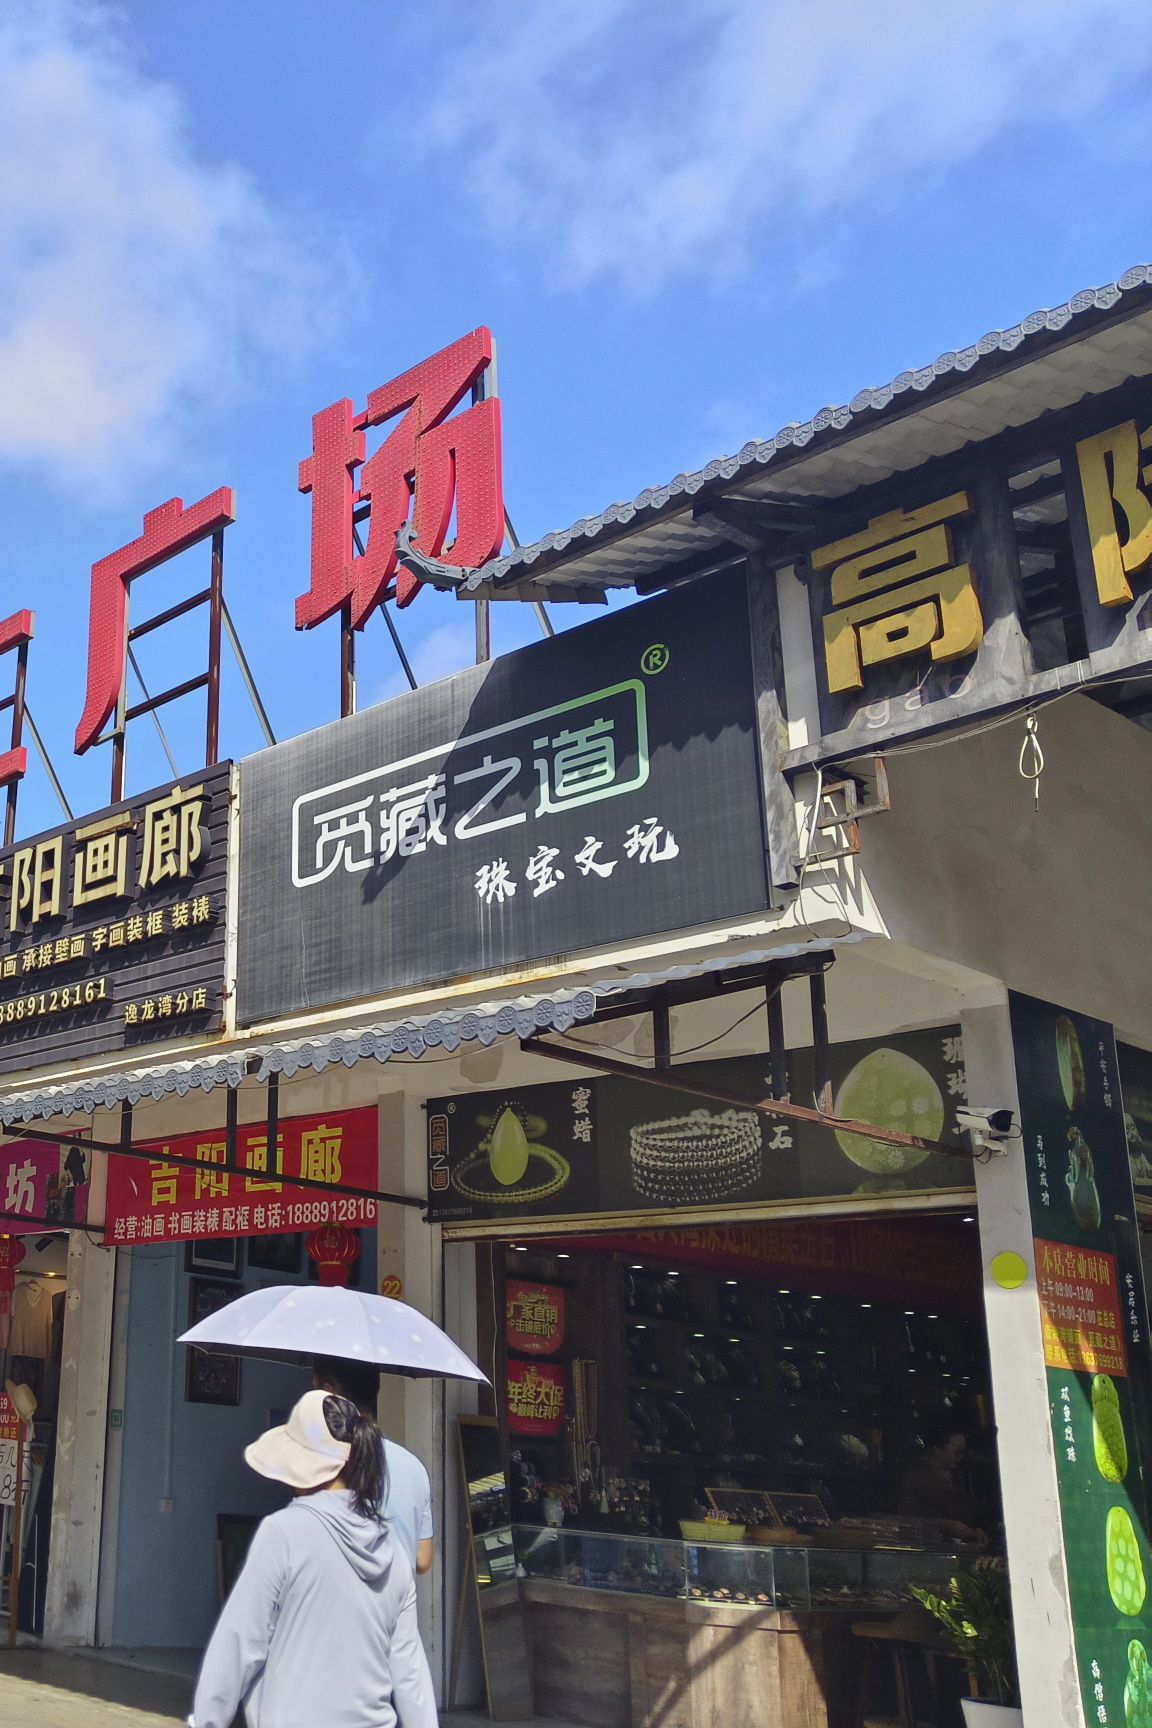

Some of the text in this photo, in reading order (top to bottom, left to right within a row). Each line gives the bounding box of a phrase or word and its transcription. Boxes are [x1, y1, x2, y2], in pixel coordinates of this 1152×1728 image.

[313, 717, 617, 875] 觅藏之道
[474, 817, 679, 905] 珠宝文玩
[22, 934, 86, 972] 承接壁画
[92, 913, 163, 952] 字画装框
[172, 896, 210, 929] 装裱
[124, 987, 207, 1025] 逸龙湾分店
[571, 1086, 594, 1143] 蜜蜡
[149, 1124, 343, 1206] 吉阳画廊
[114, 1198, 378, 1240] 经营:油画 书画装裱 配框 电话:1888912816
[383, 1280, 401, 1297] 22
[1043, 1246, 1111, 1286] 本店营业时间
[508, 1382, 564, 1406] 年终大促
